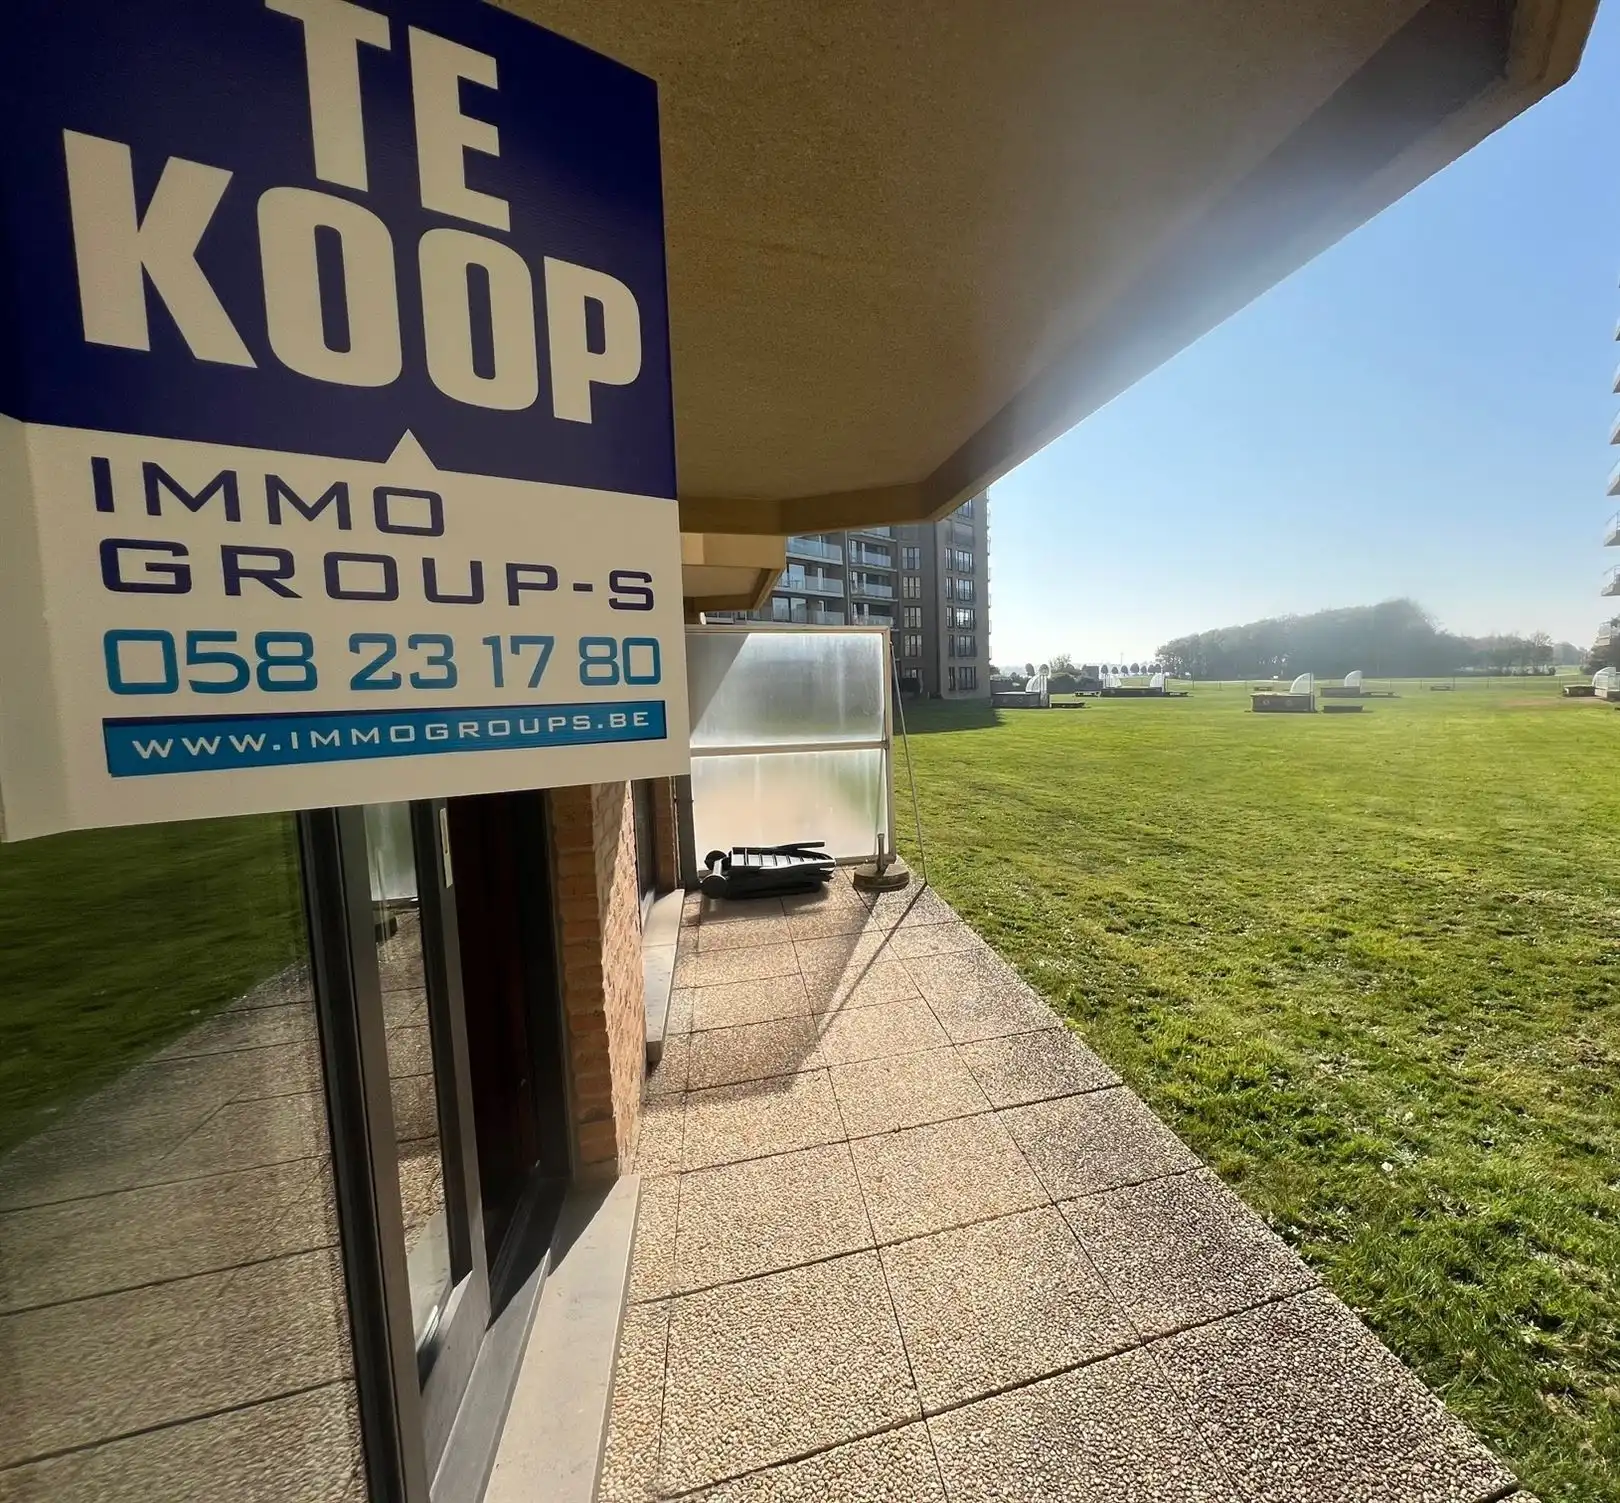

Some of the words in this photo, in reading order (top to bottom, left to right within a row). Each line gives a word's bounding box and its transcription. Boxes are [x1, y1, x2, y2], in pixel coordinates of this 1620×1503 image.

[264, 0, 511, 232] TE
[63, 128, 642, 424] KOOP
[90, 456, 445, 537] IMMO
[99, 538, 655, 611] GROUP-S
[103, 629, 319, 695] 058
[348, 633, 458, 690] 23
[482, 635, 555, 688] 17
[578, 636, 662, 686] 80
[132, 711, 650, 759] WWW.IMMOGROUPS.BE
